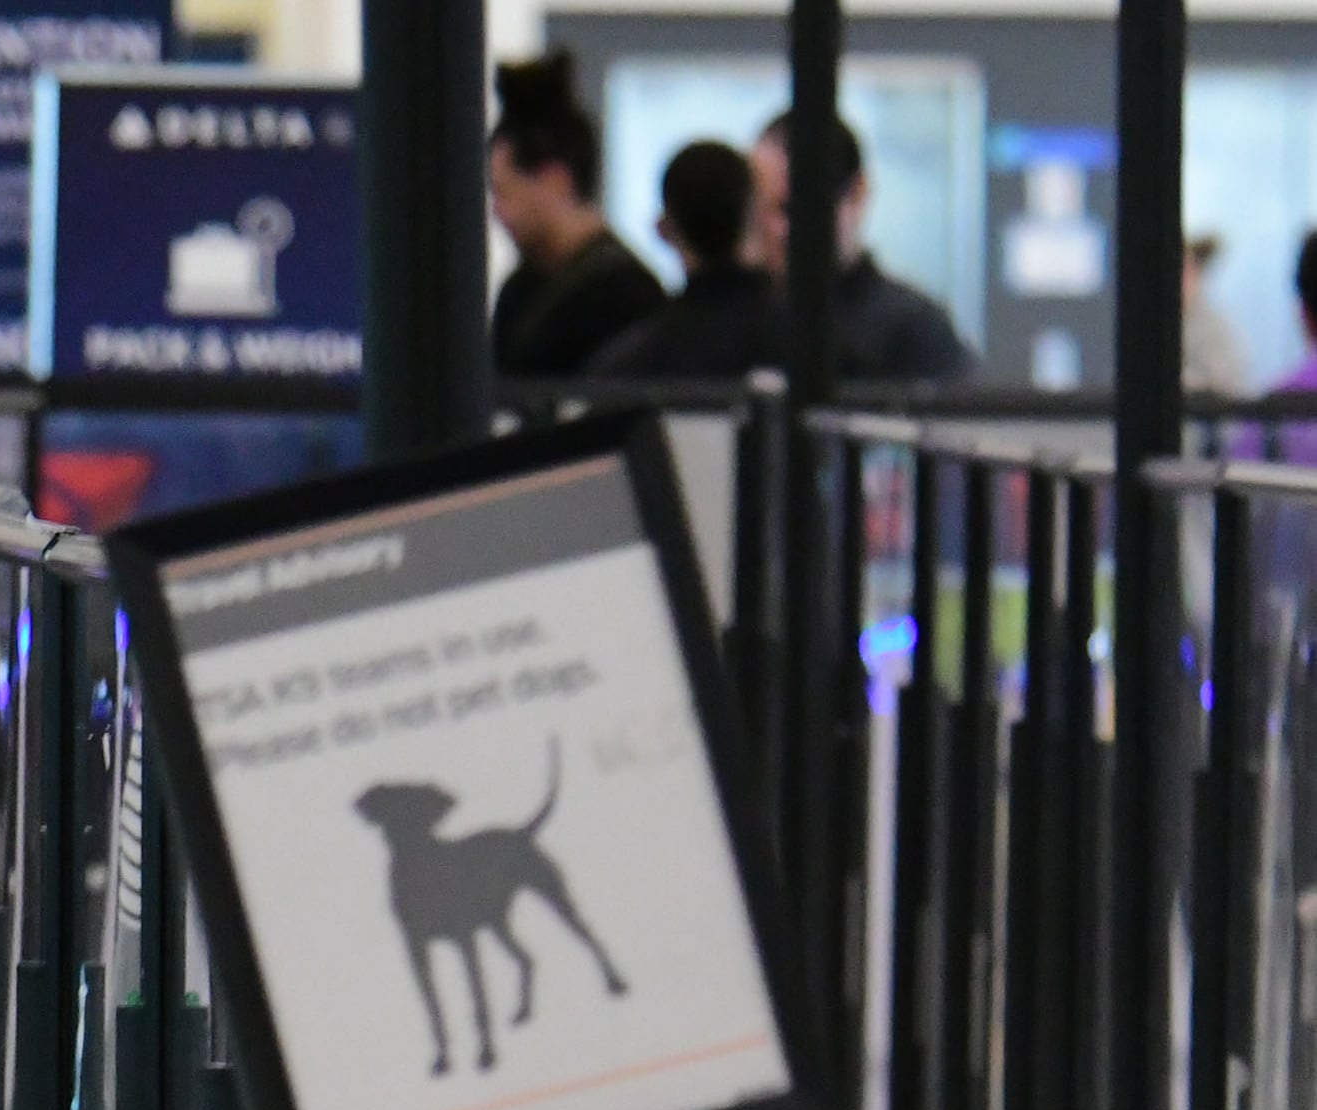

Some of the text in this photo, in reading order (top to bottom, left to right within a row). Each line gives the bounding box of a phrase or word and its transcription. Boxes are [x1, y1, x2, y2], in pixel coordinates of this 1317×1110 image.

[155, 103, 314, 150] DELTA
[83, 323, 189, 373] PACK
[199, 325, 230, 373] &
[268, 535, 405, 592] Advisory
[194, 681, 263, 721] TSA
[272, 667, 321, 703] K9
[326, 645, 433, 691] teams
[440, 634, 474, 664] in
[205, 726, 321, 772] Please
[330, 712, 376, 748] do
[384, 691, 437, 729] not
[448, 677, 500, 722] pet
